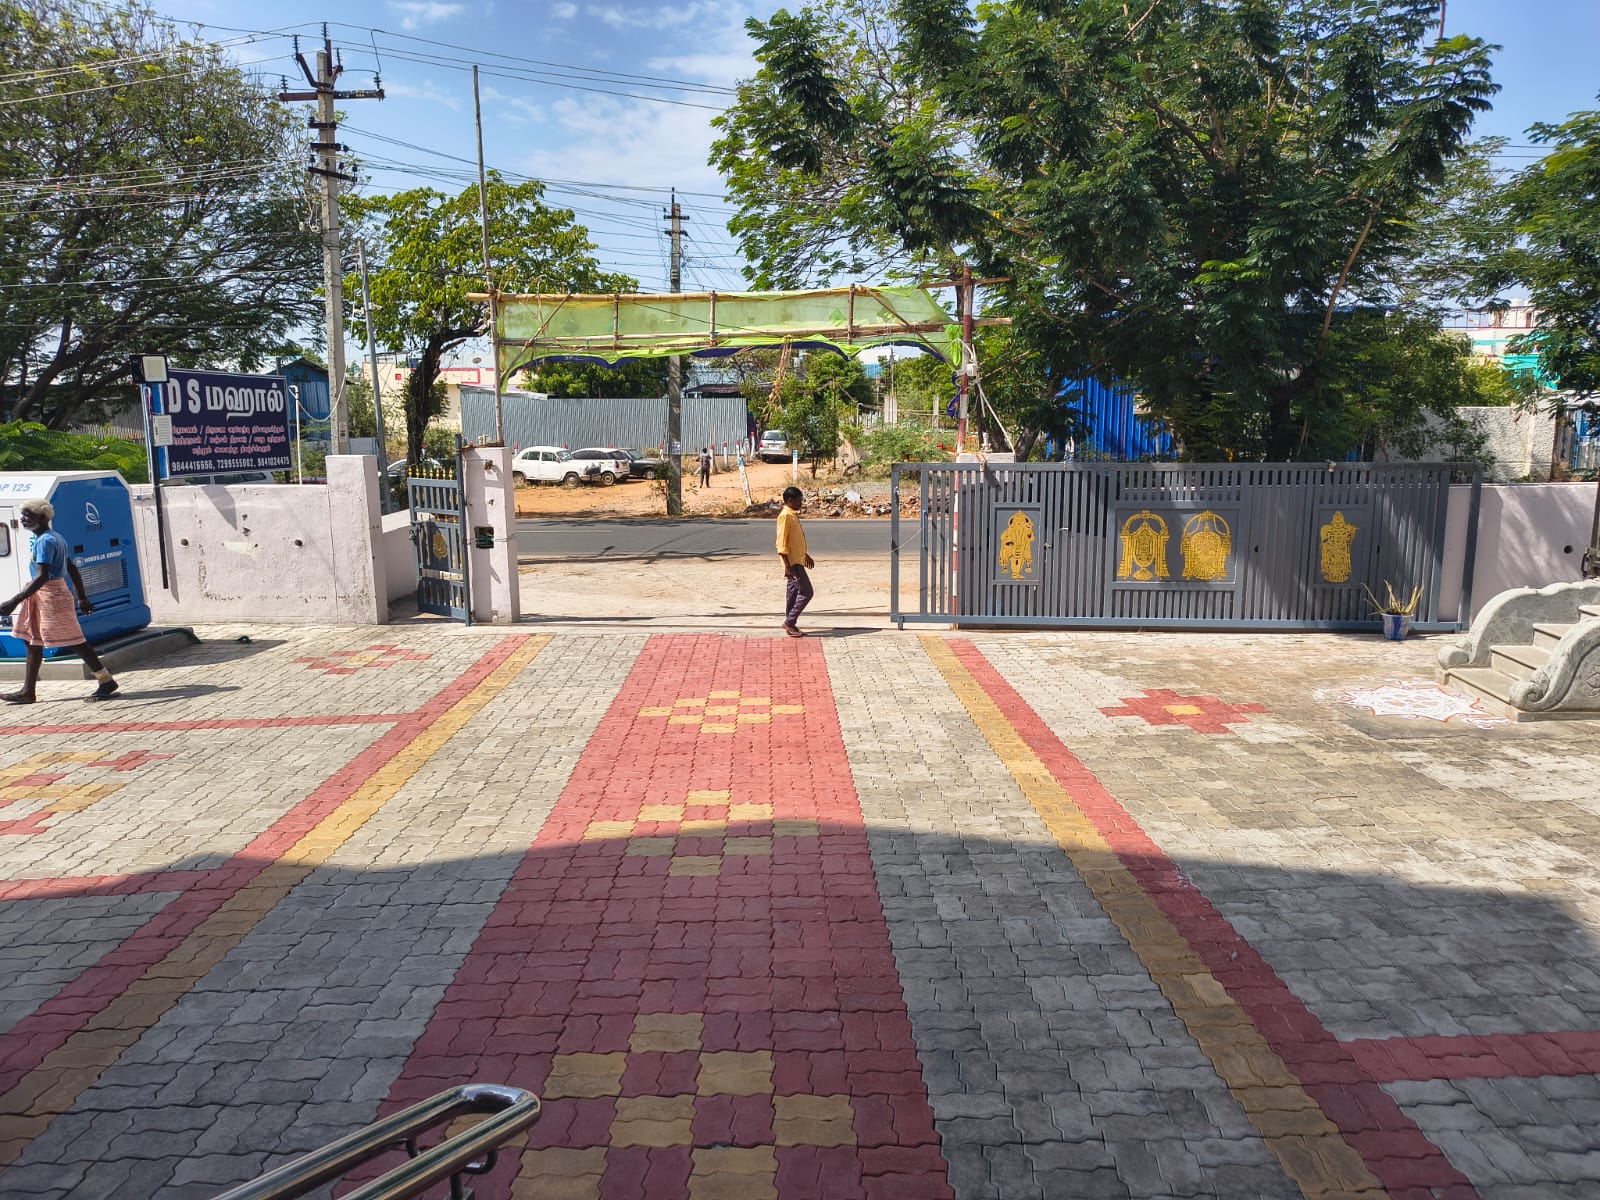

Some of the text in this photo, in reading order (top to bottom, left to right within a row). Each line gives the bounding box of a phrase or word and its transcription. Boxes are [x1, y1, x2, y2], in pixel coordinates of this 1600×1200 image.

[168, 378, 181, 413] D
[187, 378, 201, 414] S
[12, 483, 32, 492] 125
